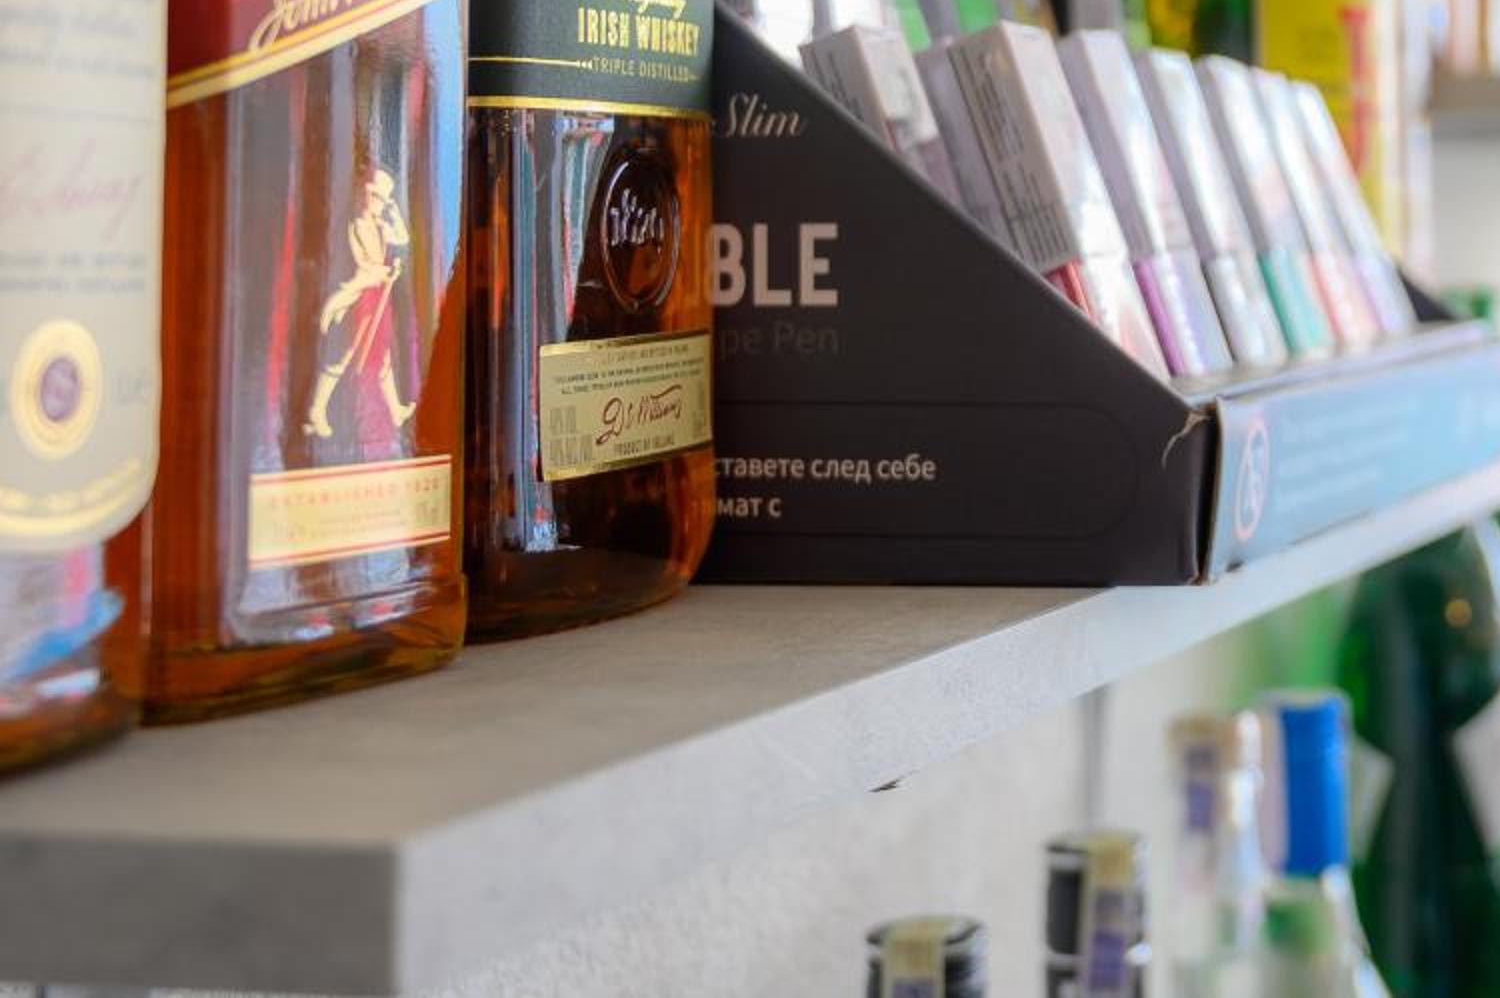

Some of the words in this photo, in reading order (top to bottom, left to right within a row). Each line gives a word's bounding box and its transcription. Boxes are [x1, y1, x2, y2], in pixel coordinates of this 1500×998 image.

[577, 6, 631, 49] IRISH
[634, 14, 701, 57] WHISKEY
[718, 91, 804, 138] Slim
[703, 222, 839, 307] BLE
[720, 328, 763, 363] pe
[810, 456, 873, 485] след
[876, 452, 937, 481] себе
[716, 496, 763, 518] мат
